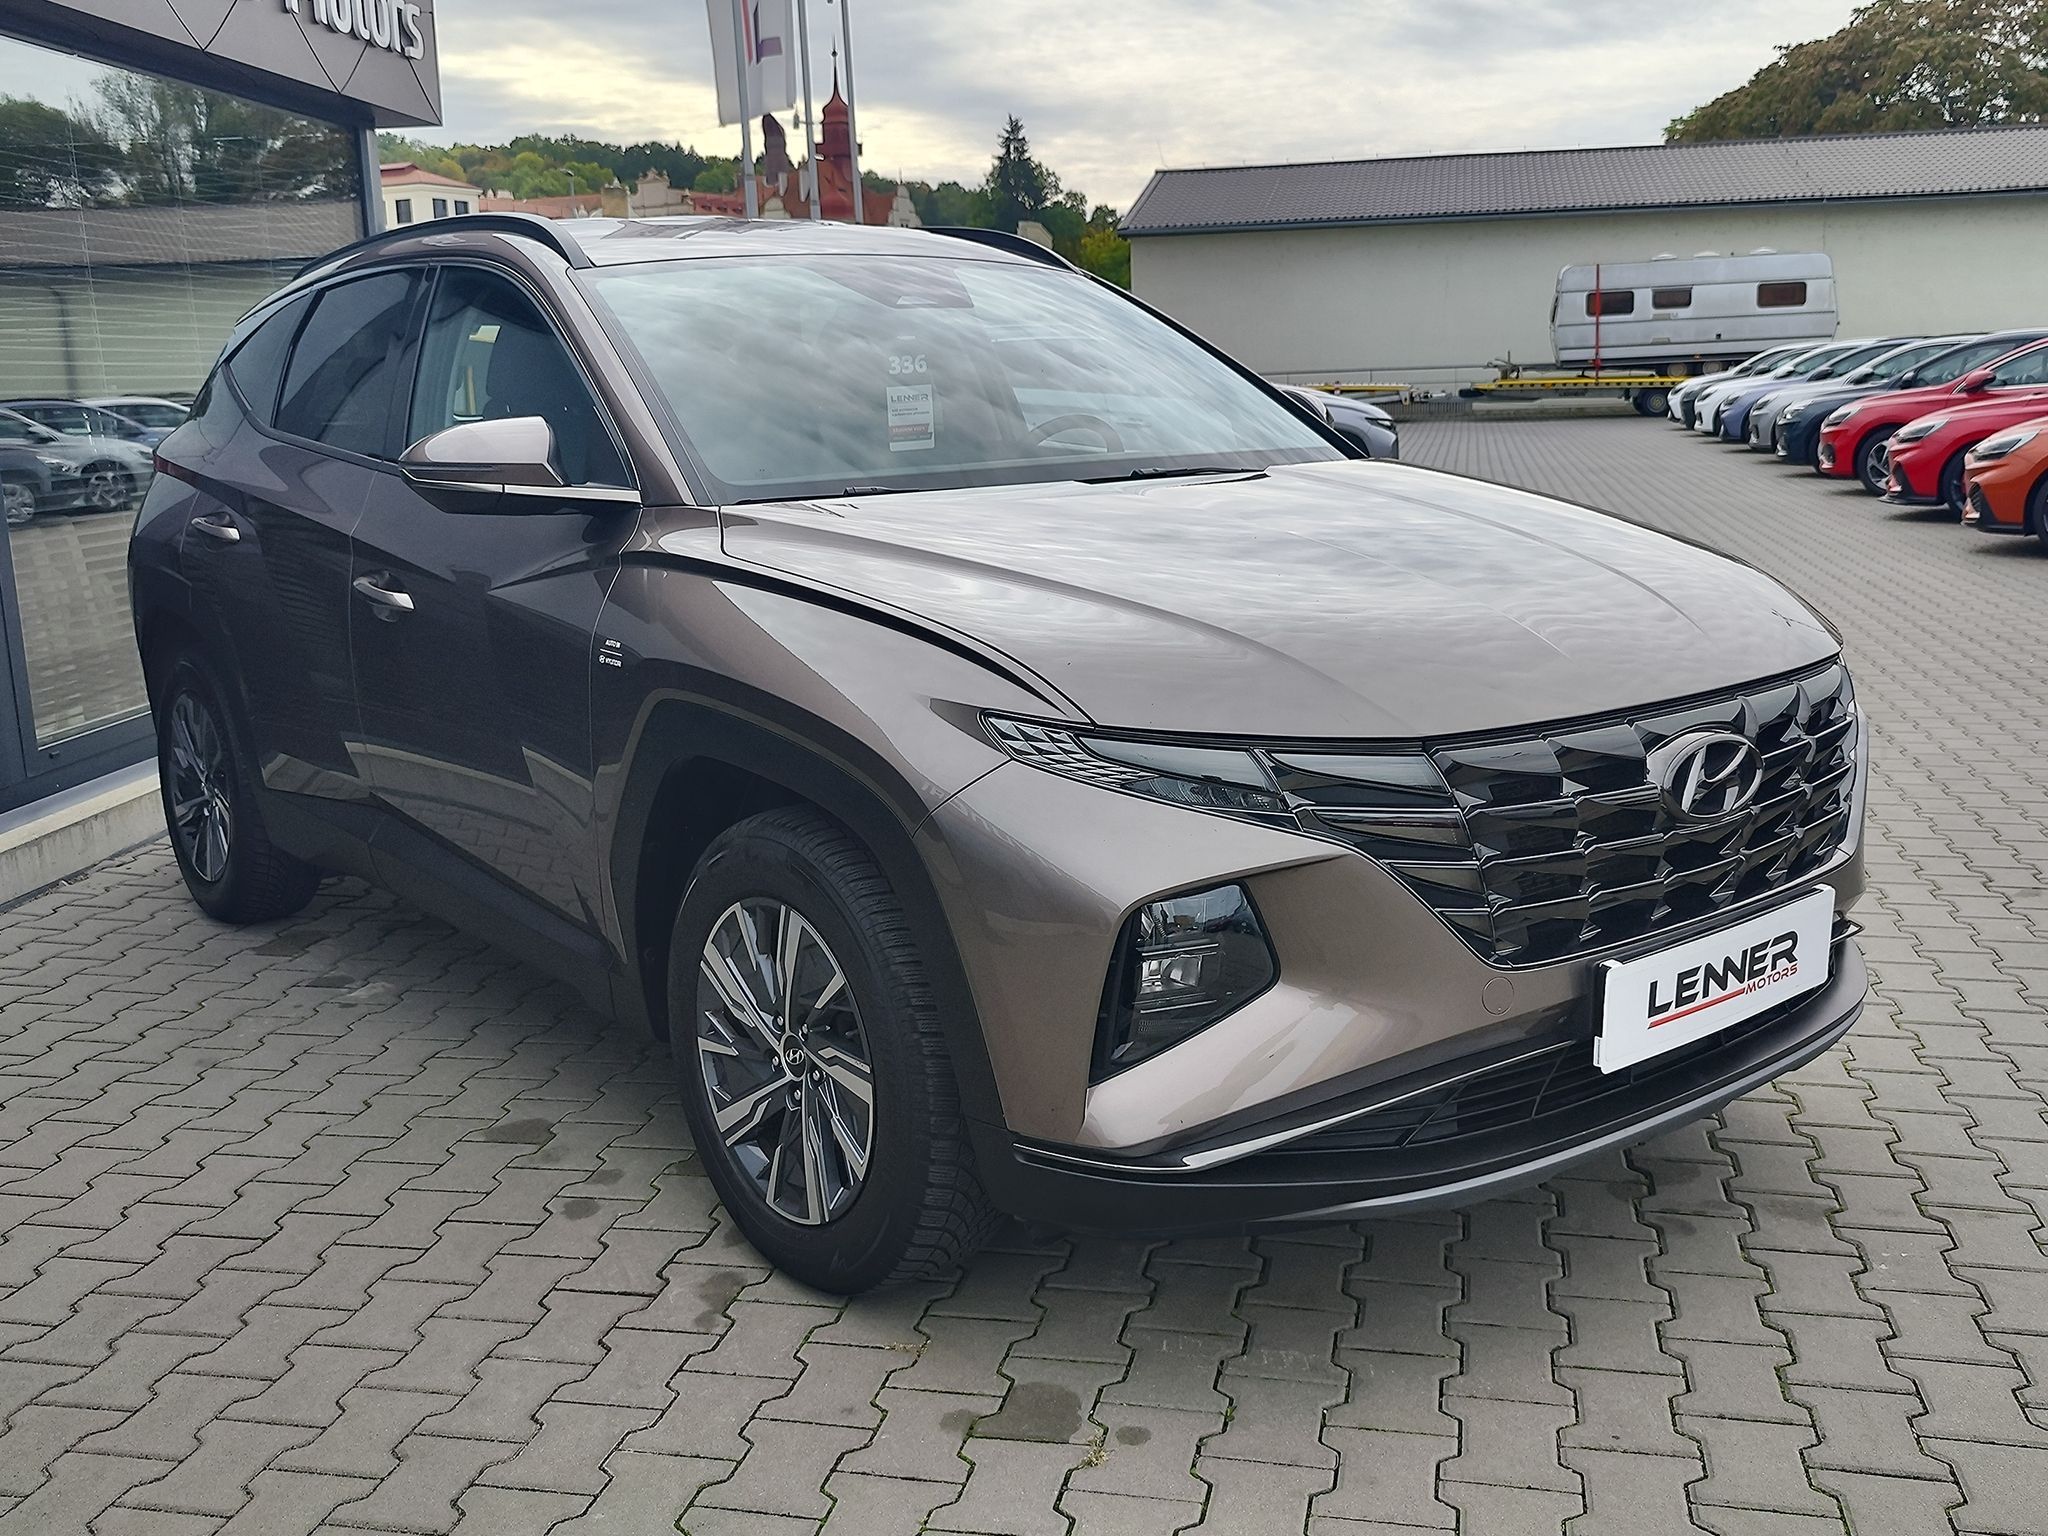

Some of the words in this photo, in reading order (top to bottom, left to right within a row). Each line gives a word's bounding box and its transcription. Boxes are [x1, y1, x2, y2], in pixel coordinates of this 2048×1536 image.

[283, 0, 425, 60] otors
[887, 354, 928, 375] 336
[1647, 930, 1799, 1018] LENNER
[1745, 963, 1799, 995] MOTORS
